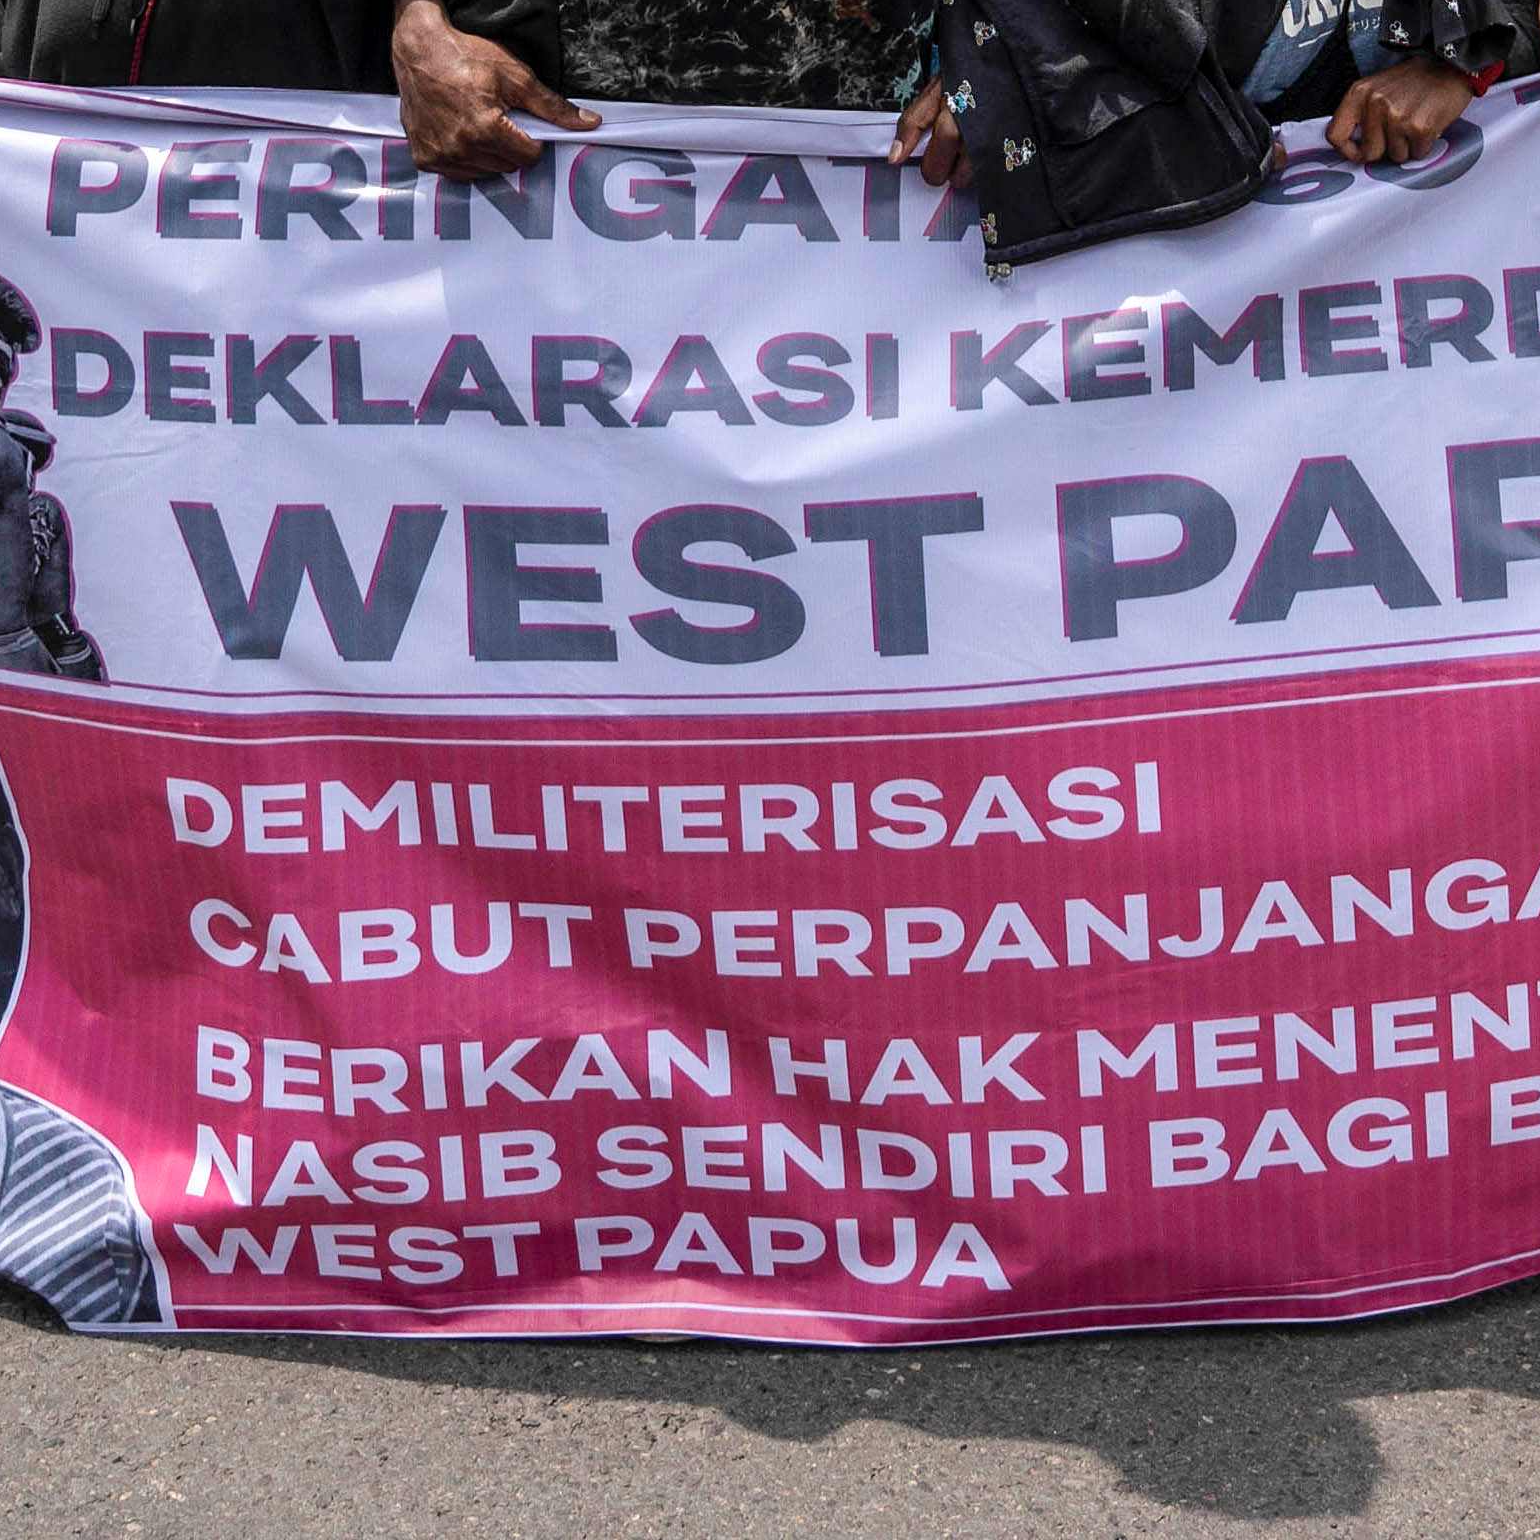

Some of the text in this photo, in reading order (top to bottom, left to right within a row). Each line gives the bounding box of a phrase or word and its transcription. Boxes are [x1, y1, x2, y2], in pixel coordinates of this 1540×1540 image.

[50, 325, 901, 429] DEKLARASI
[169, 491, 986, 665] WEST
[164, 760, 1163, 855] DEMILITERISASI
[188, 897, 593, 985] CABUT
[194, 1022, 734, 1117] BERIKAN
[767, 1031, 1047, 1108] HAK
[185, 1121, 562, 1208] NASIB
[594, 1120, 1109, 1201] SENDIRI
[1148, 1089, 1450, 1191] BAGI
[173, 1210, 1013, 1293] WEST PAPUA
